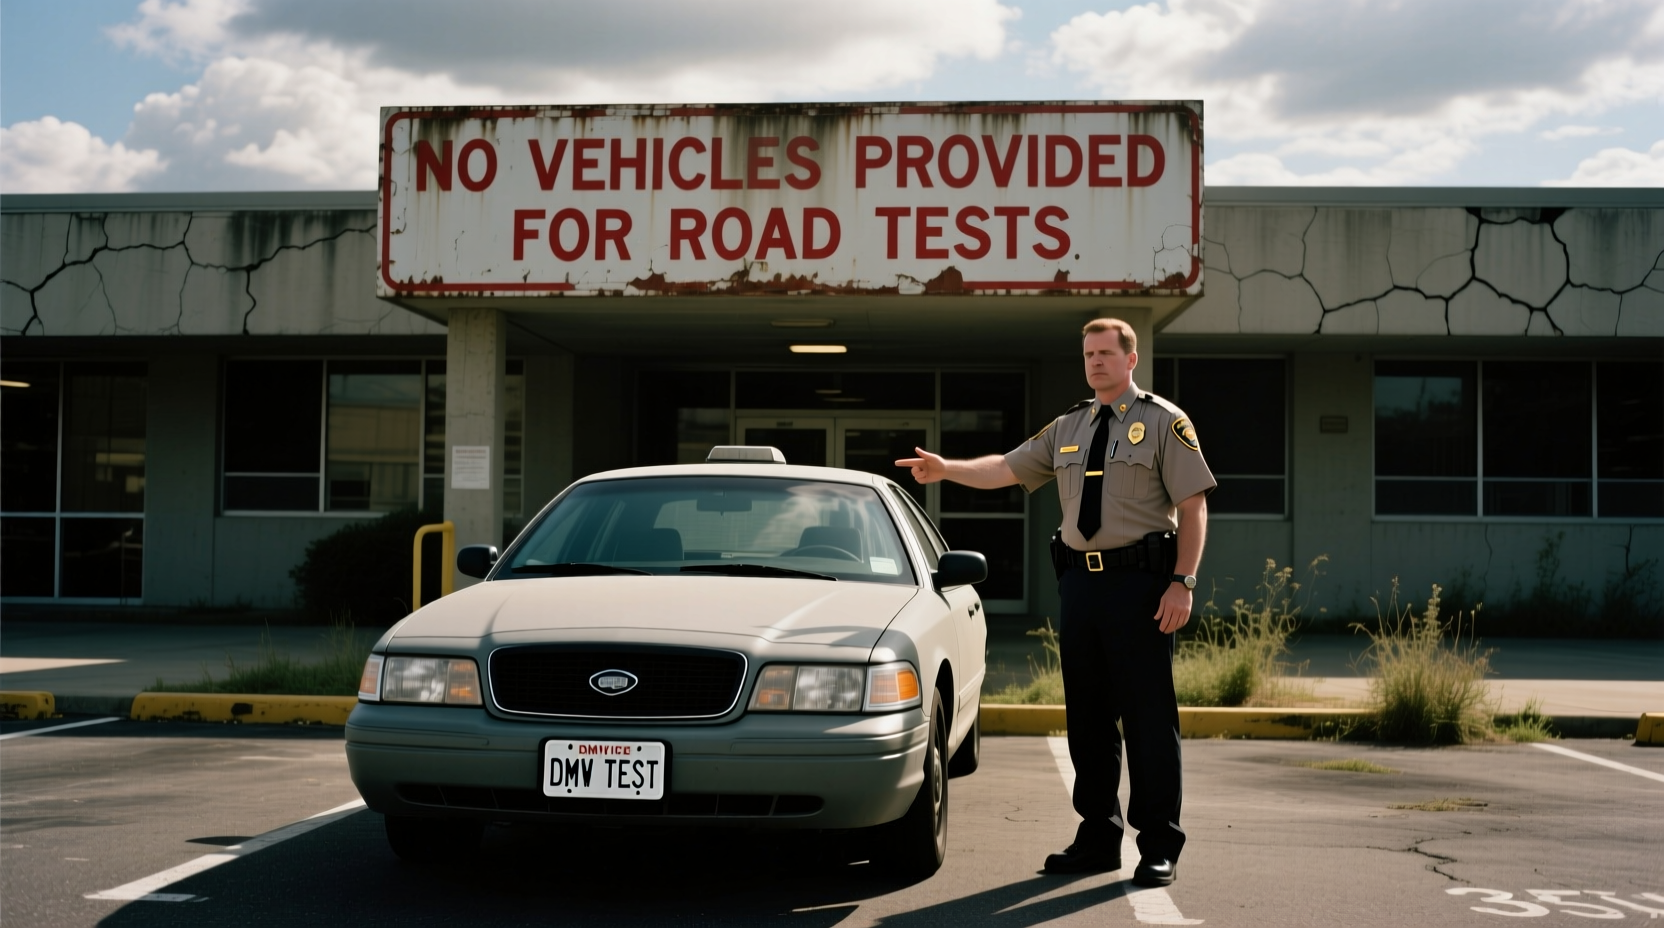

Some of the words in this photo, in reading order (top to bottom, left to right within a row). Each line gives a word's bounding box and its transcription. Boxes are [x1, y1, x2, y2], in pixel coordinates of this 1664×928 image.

[416, 138, 498, 192] NO
[528, 136, 822, 191] VEHICLES
[855, 133, 1166, 189] PROVIDED
[513, 207, 633, 262] FOR
[669, 206, 841, 260] ROAD
[550, 758, 594, 788] DMV
[604, 759, 659, 789] TEST
